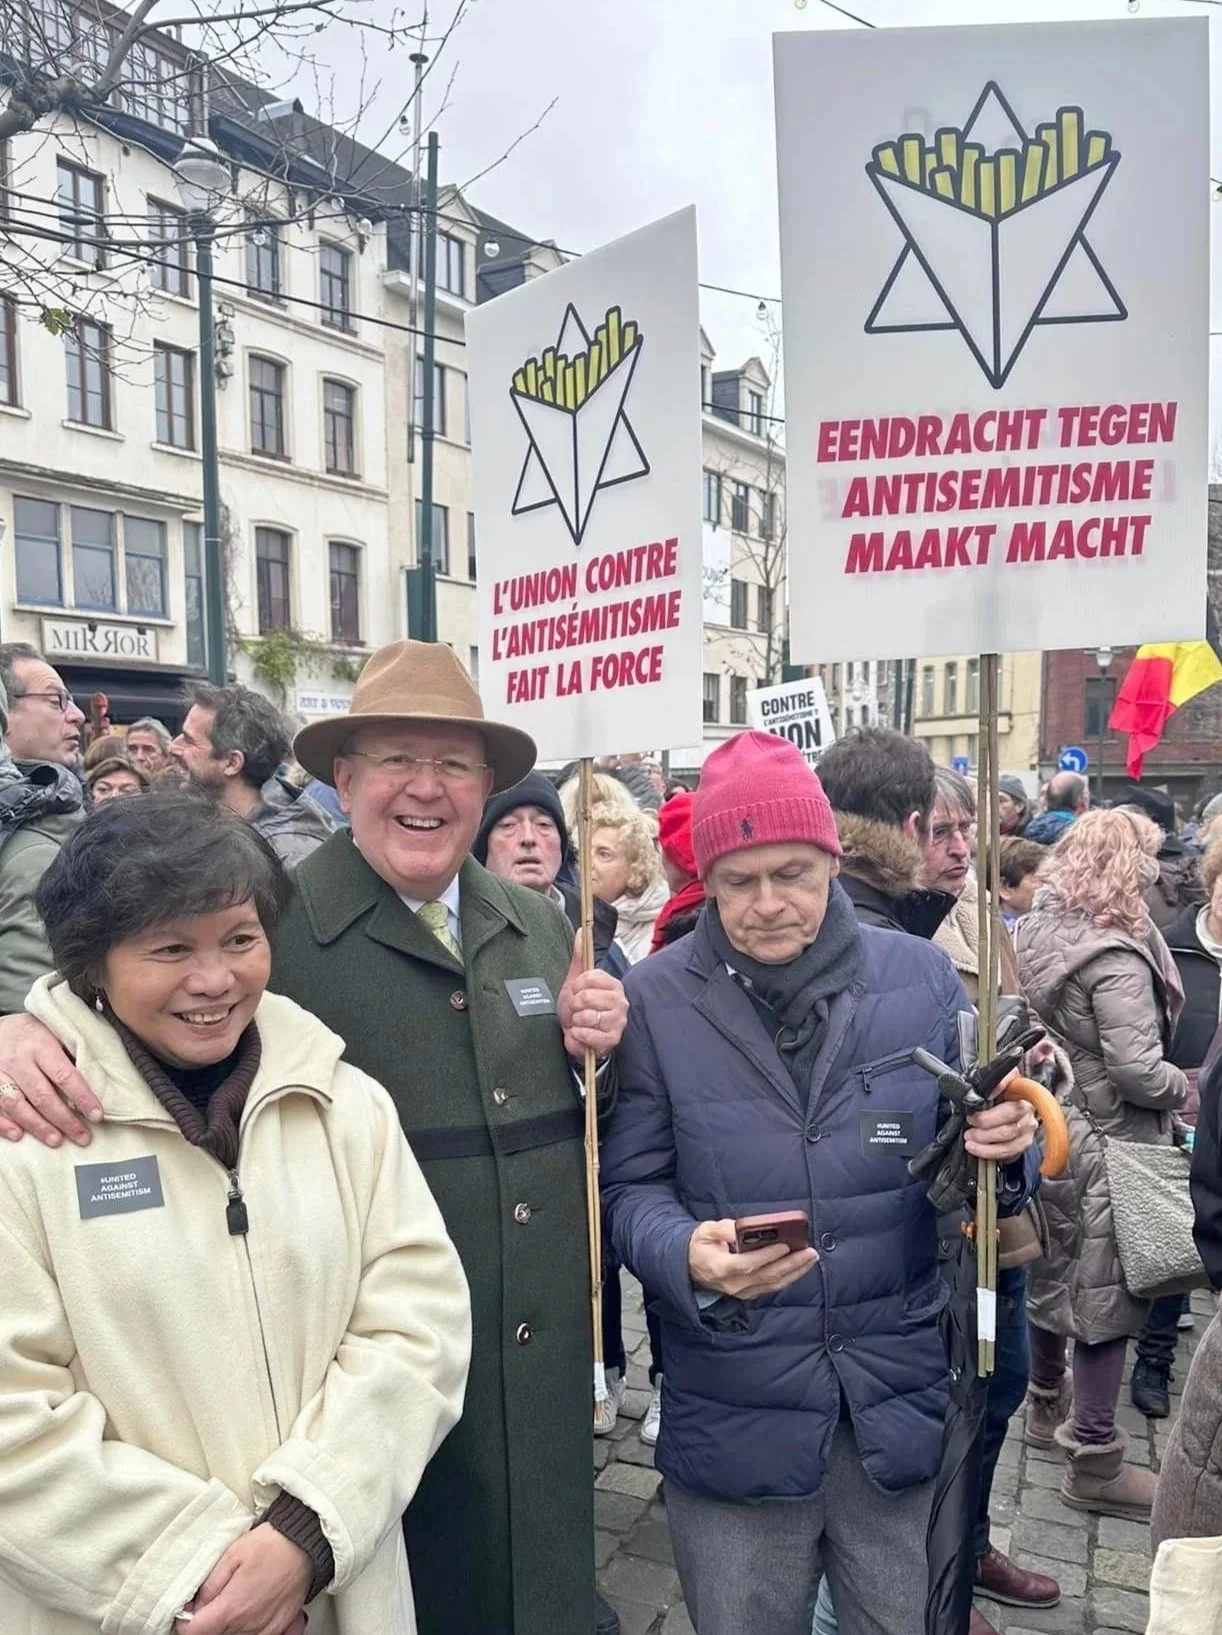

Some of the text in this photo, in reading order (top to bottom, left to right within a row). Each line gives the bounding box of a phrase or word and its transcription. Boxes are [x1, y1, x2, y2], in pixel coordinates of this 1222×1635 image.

[817, 402, 1177, 462] EENDRACHT TEGEN
[841, 459, 1154, 518] ANTISEMITISME
[844, 515, 1152, 573] MAAKT MACHT
[493, 537, 678, 615] L'UNION CONTRE
[492, 590, 682, 661] L'ANTISÉMITISME
[506, 645, 664, 704] FAIT LA FORCE
[761, 690, 815, 717] CONTRE
[90, 1187, 152, 1202] ANTISEMITISM
[100, 1173, 137, 1183] #UNITED
[100, 1181, 138, 1193] AGAINST
